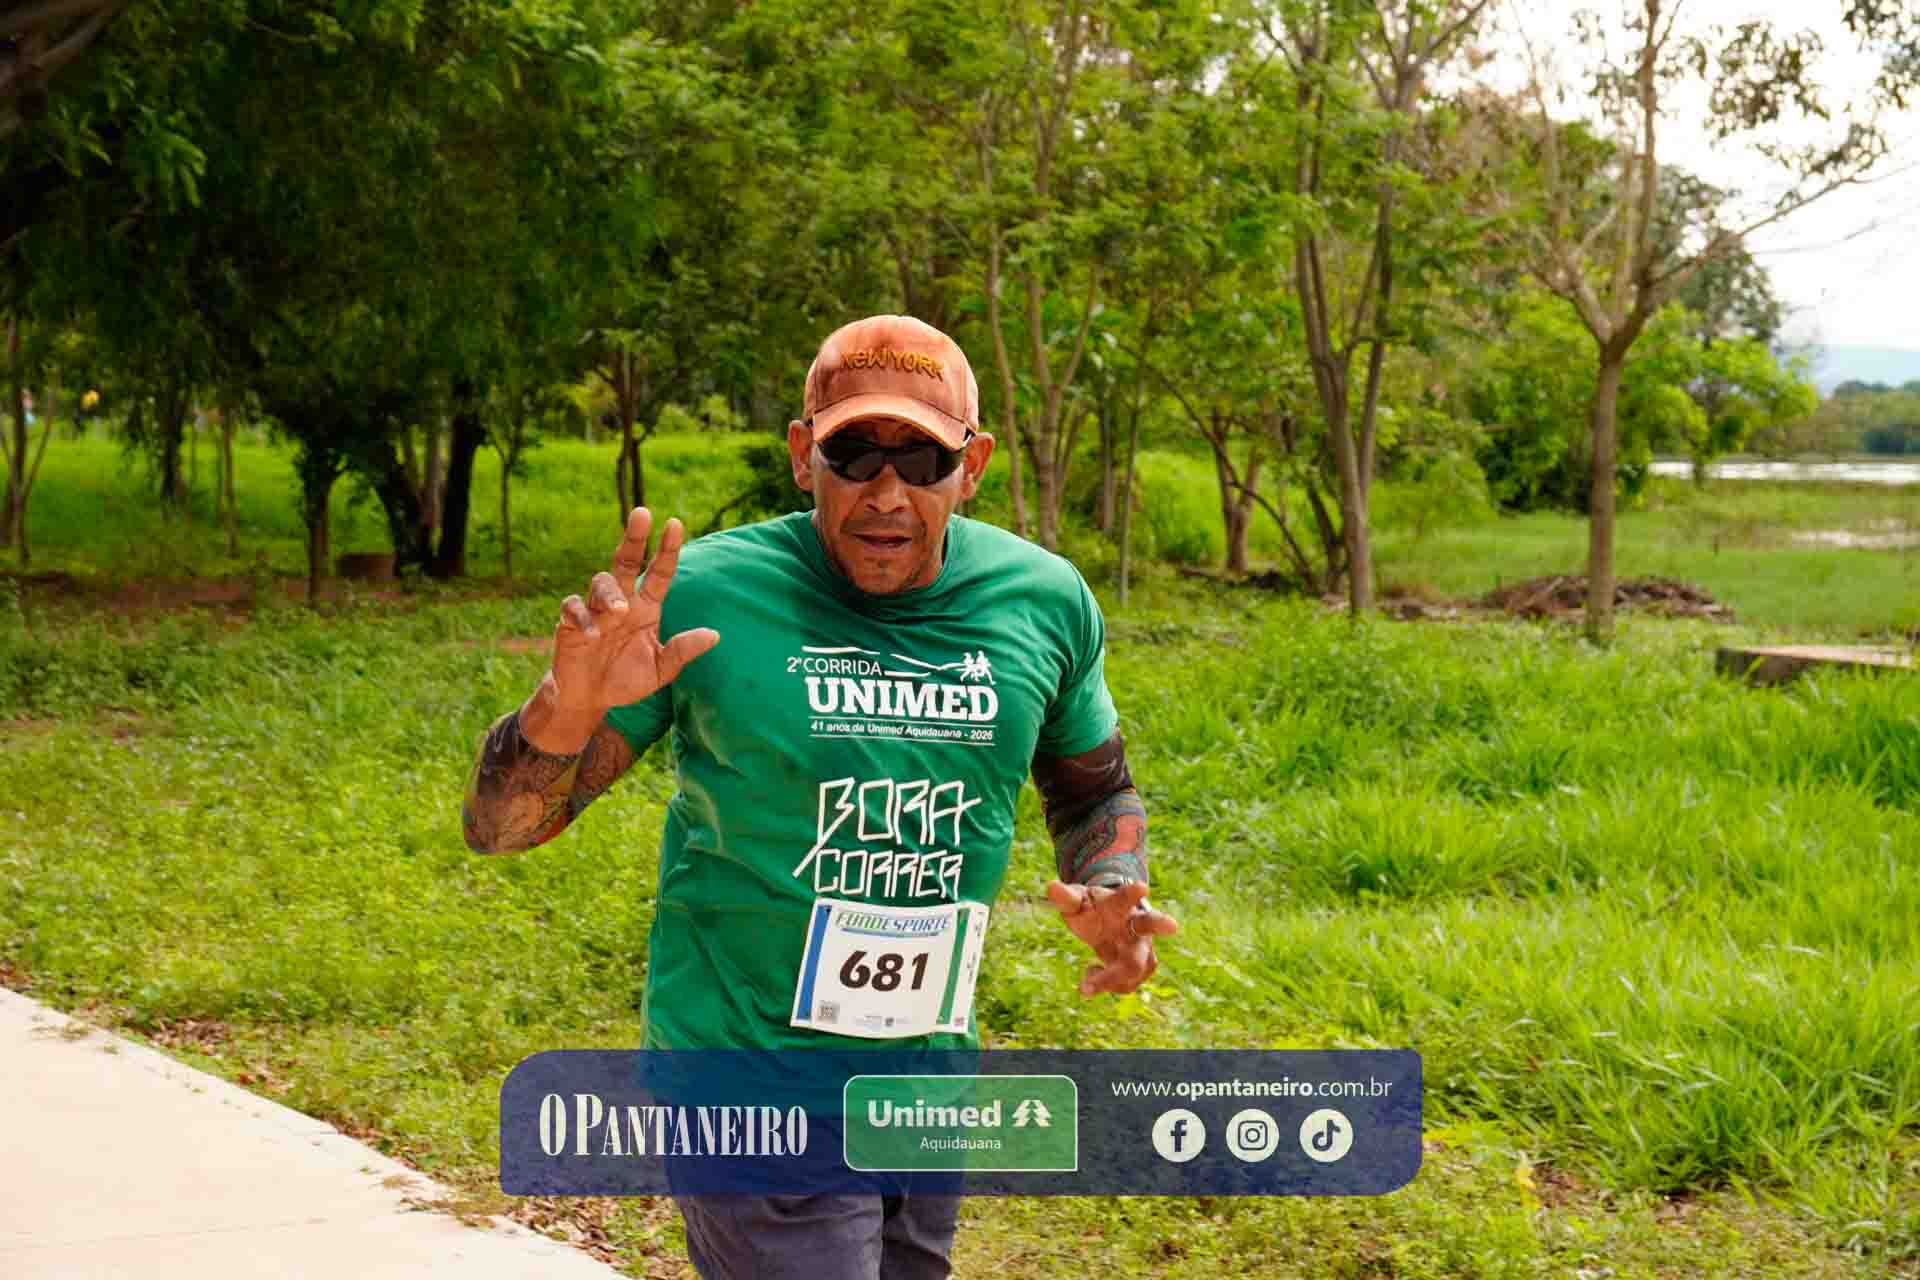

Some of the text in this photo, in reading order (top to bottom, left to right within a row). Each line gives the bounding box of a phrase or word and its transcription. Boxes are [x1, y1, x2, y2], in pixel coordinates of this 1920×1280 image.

[890, 349, 946, 382] YORK
[803, 657, 882, 677] CORRIDA
[805, 676, 999, 722] UNIMED
[810, 719, 825, 732] 41
[826, 722, 851, 733] anos
[851, 722, 866, 733] da
[867, 723, 904, 736] Unimed
[905, 725, 962, 739] Aquidauana
[792, 776, 982, 878] BORA
[814, 849, 963, 901] CORRER
[839, 950, 929, 992] 681
